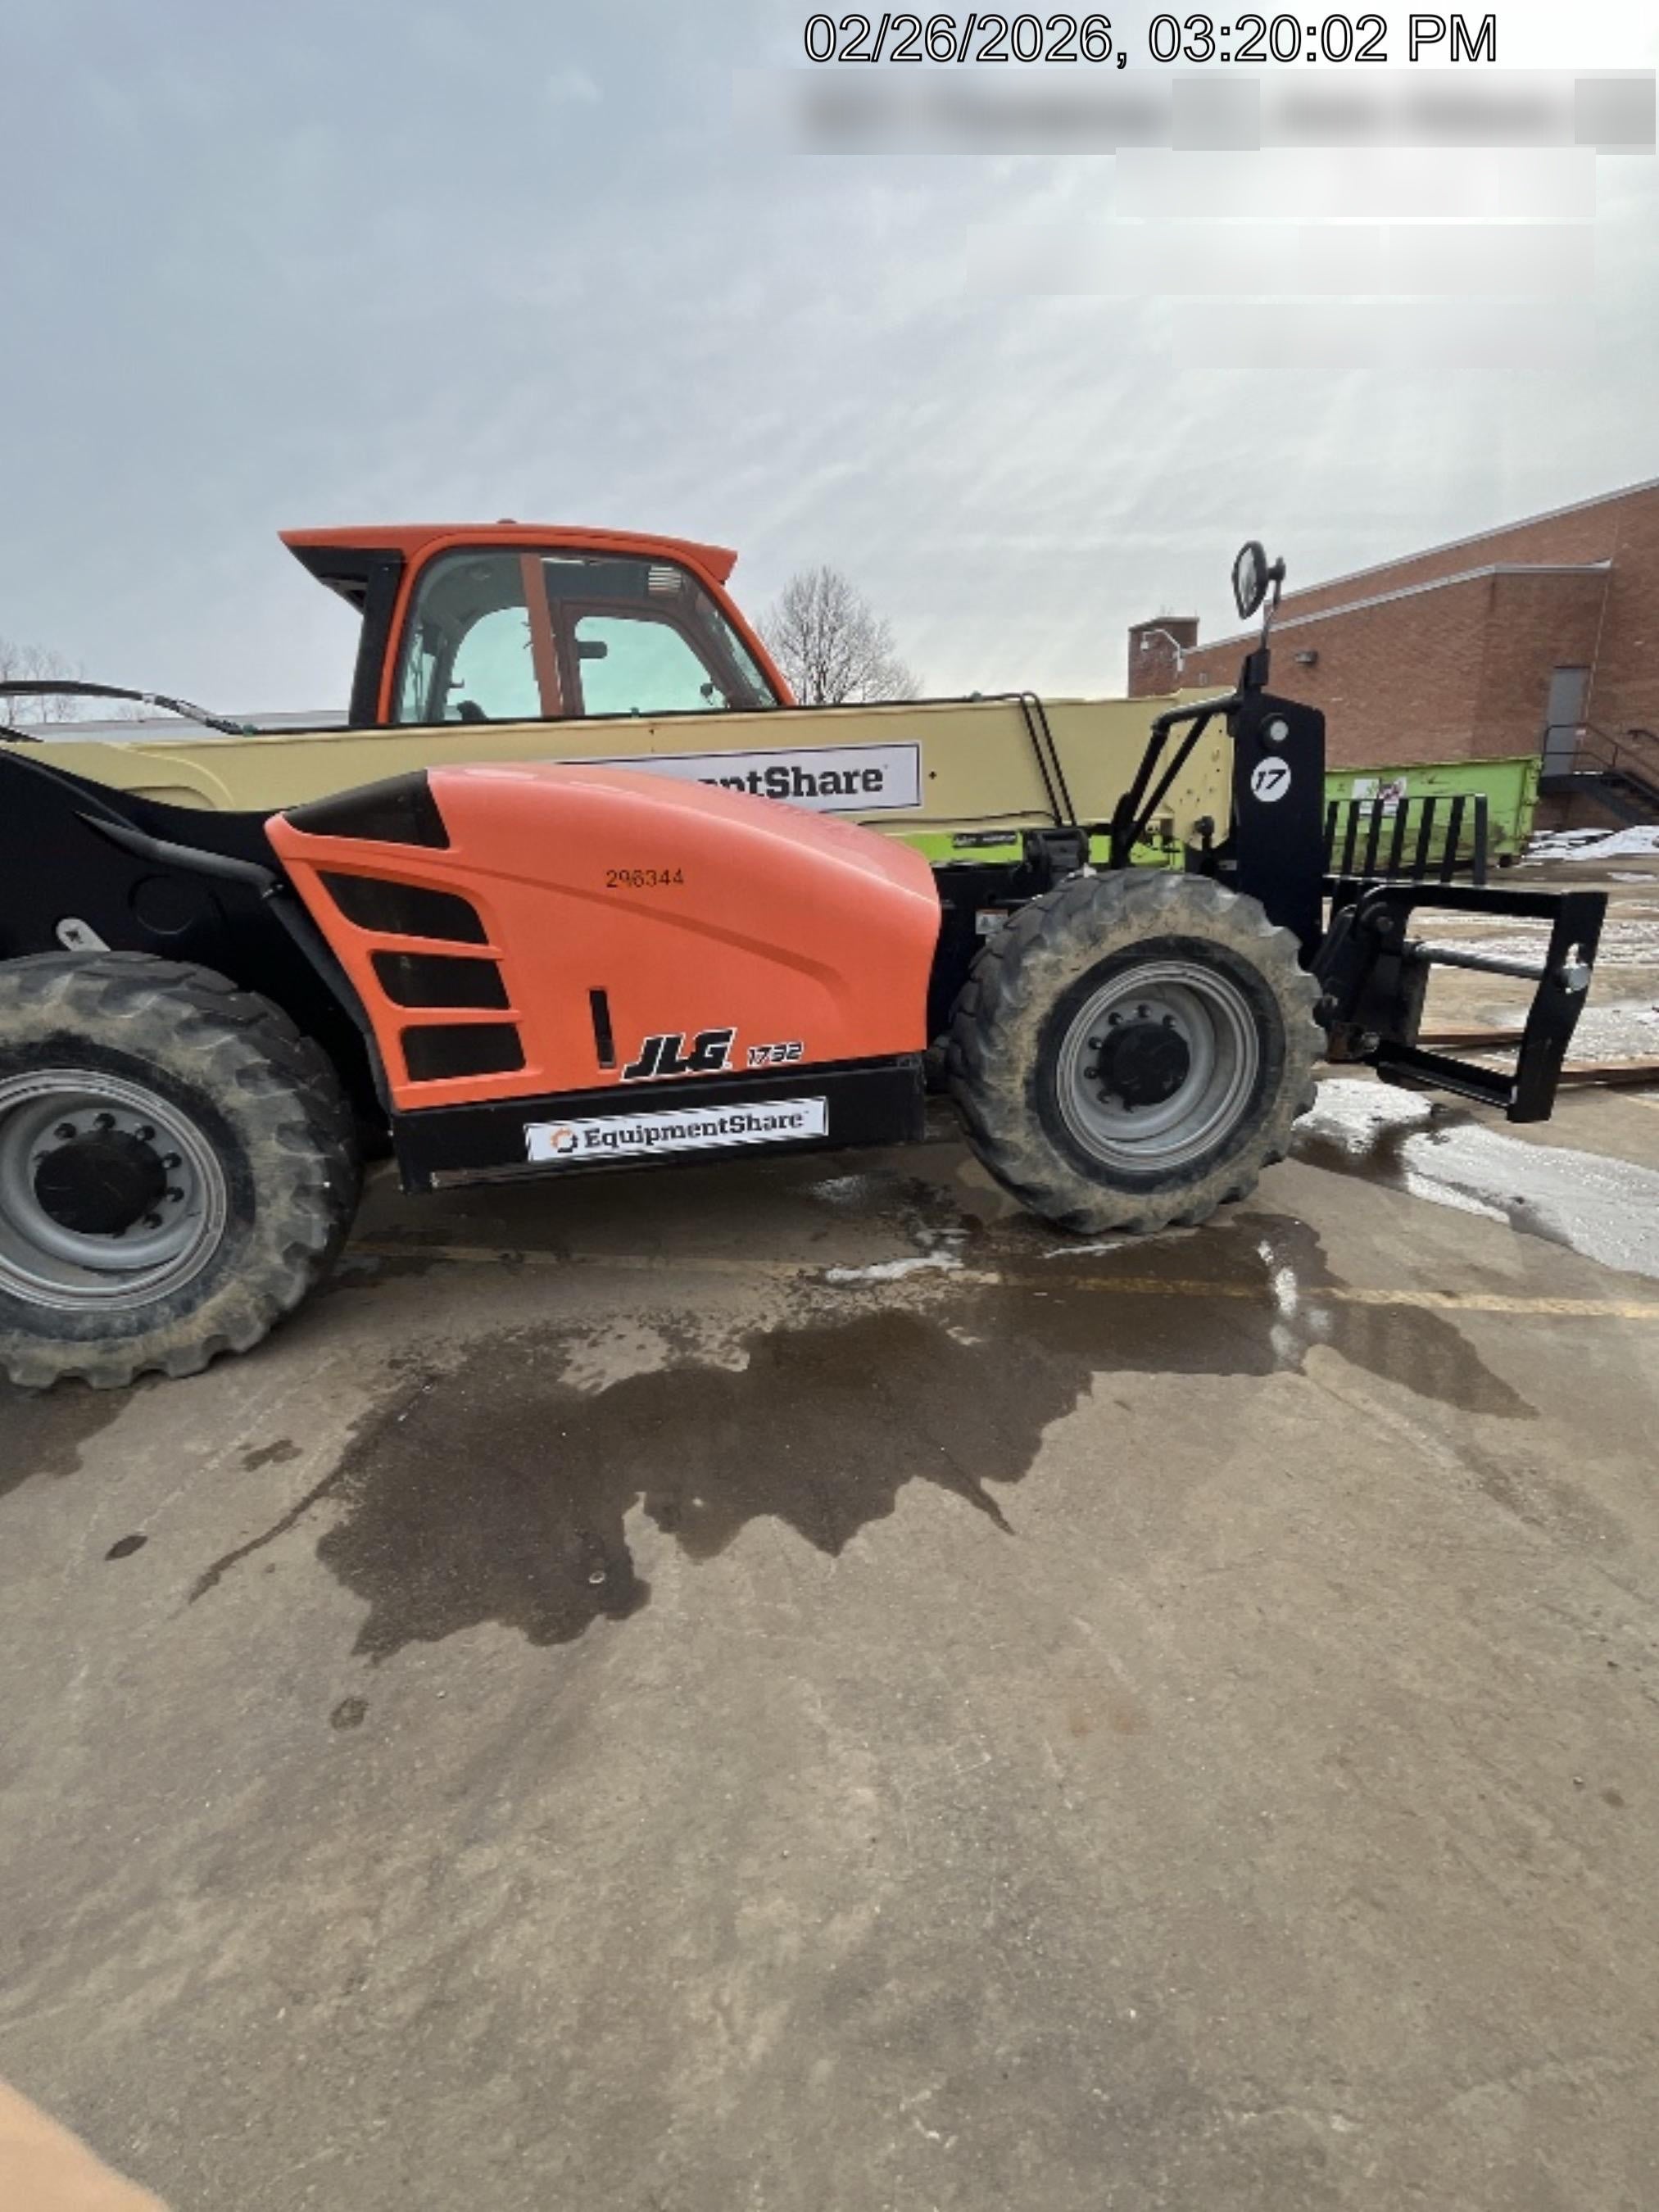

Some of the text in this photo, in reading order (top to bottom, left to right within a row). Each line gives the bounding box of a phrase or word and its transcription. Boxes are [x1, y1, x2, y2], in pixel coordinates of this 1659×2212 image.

[1254, 768, 1286, 791] 17
[606, 868, 684, 888] 296344
[620, 1027, 805, 1083] JLG 1732
[583, 1111, 805, 1150] EquipmentShare
